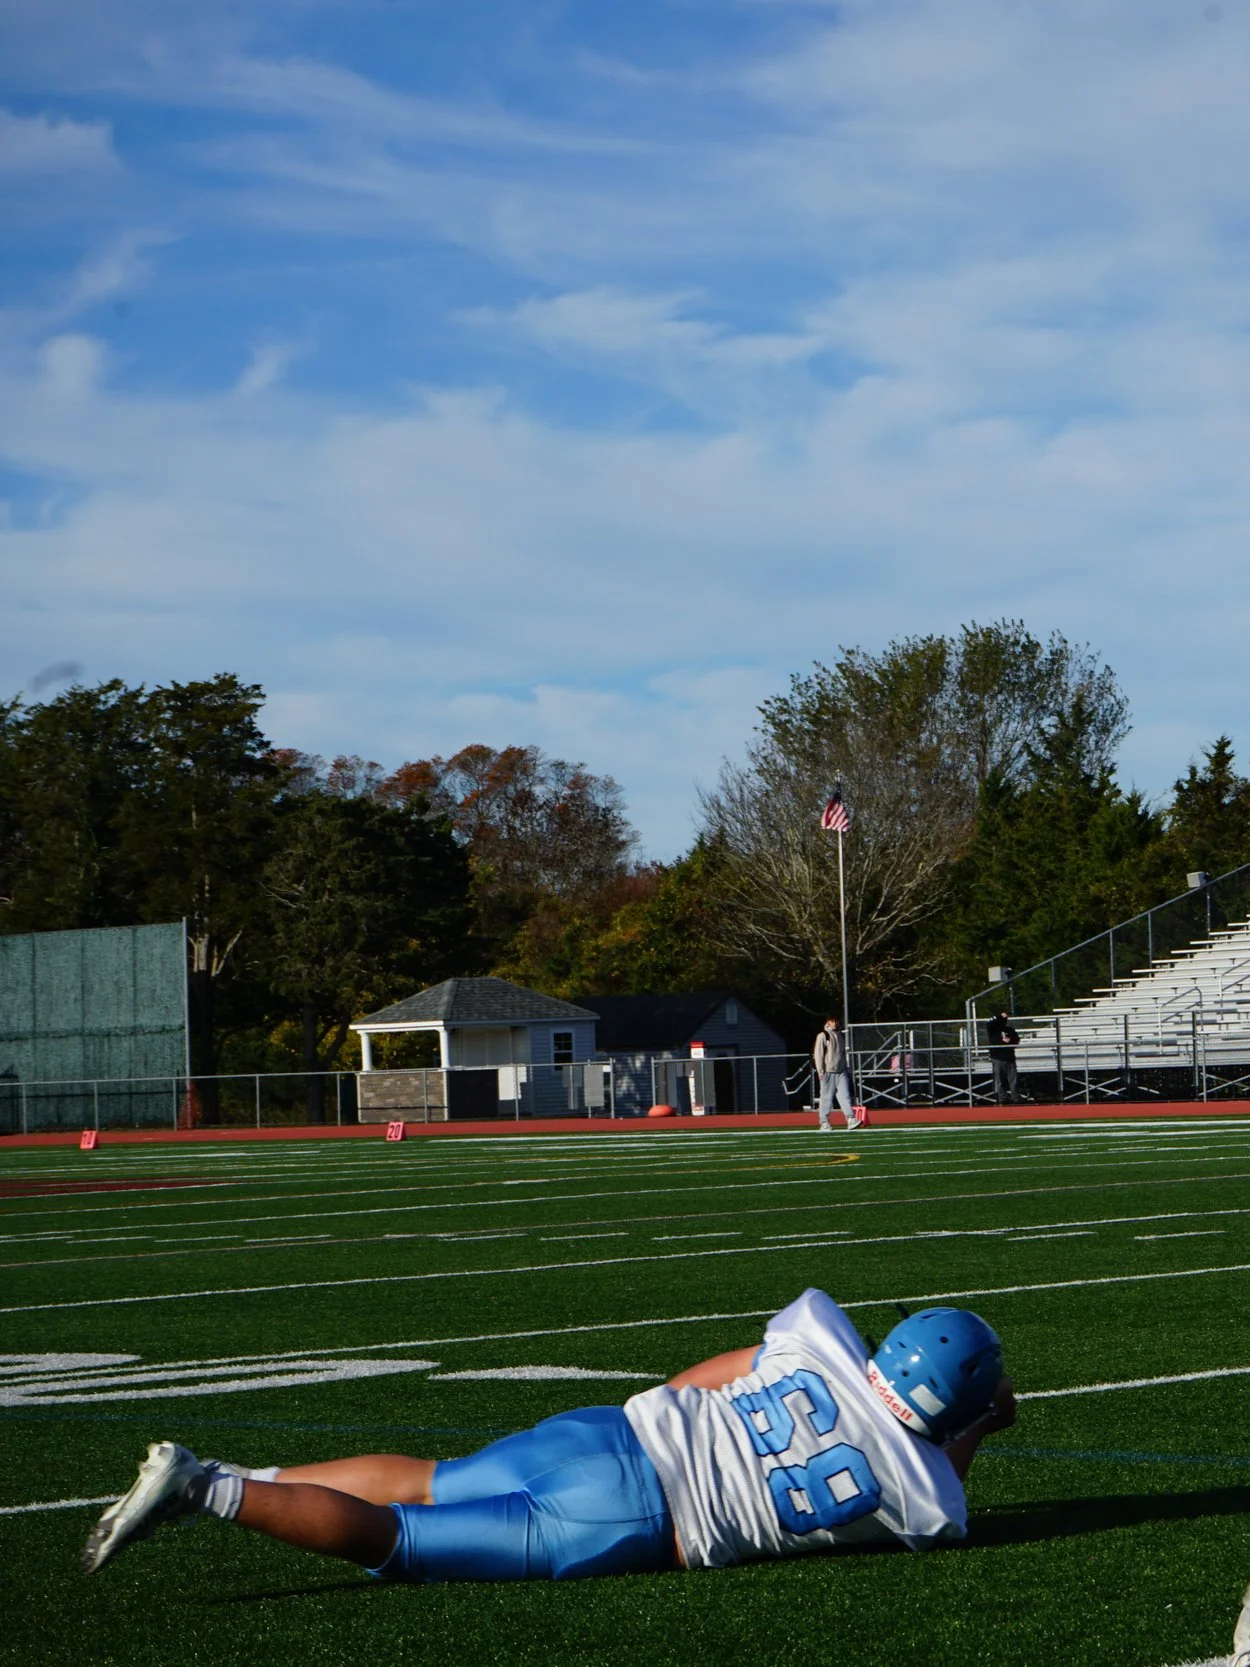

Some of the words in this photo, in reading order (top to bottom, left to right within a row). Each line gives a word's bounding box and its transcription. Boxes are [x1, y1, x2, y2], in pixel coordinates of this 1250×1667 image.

[388, 1124, 401, 1139] 20
[867, 1370, 913, 1421] Riddell
[731, 1368, 882, 1536] 68
